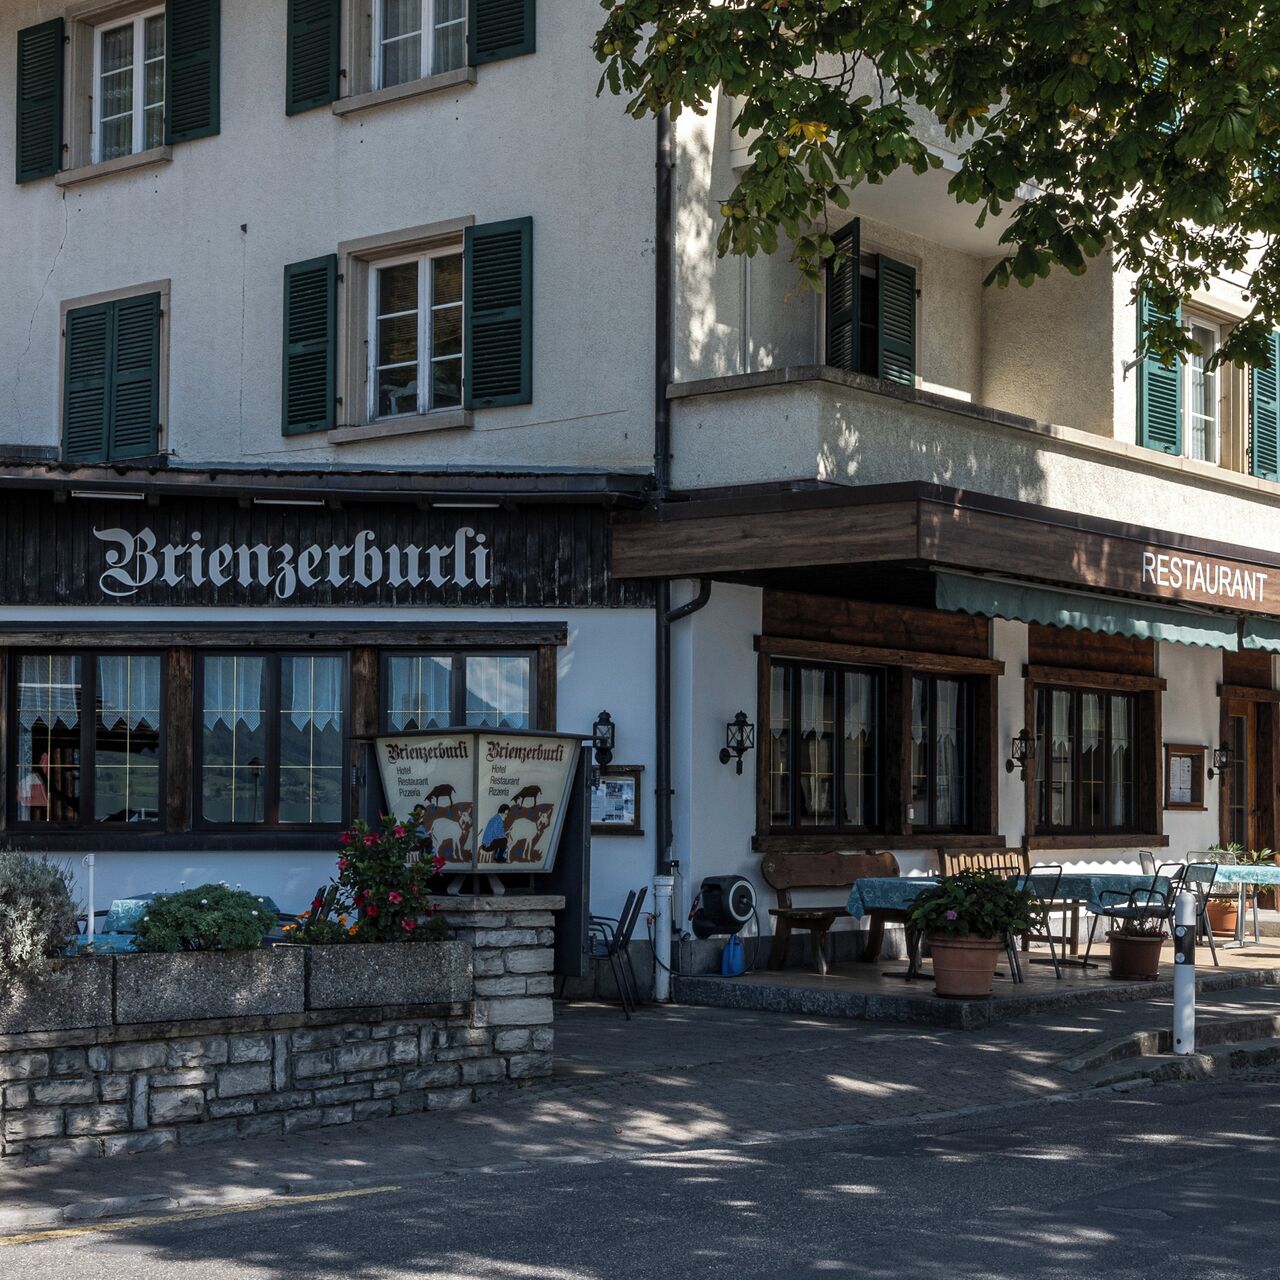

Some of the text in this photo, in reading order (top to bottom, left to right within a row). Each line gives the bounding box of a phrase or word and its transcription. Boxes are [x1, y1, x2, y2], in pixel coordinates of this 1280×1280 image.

[92, 525, 491, 599] Brienzerburli
[1142, 551, 1268, 603] RESTAURANT
[385, 741, 469, 764] Brienzerburli
[486, 740, 564, 764] Brienzerburli
[397, 766, 411, 775] Hotel
[491, 765, 507, 774] Hotel
[397, 777, 429, 786] Restaurant
[490, 775, 520, 786] Restaurant
[399, 788, 421, 797] Pizzeria
[488, 787, 510, 797] Pizzeria
